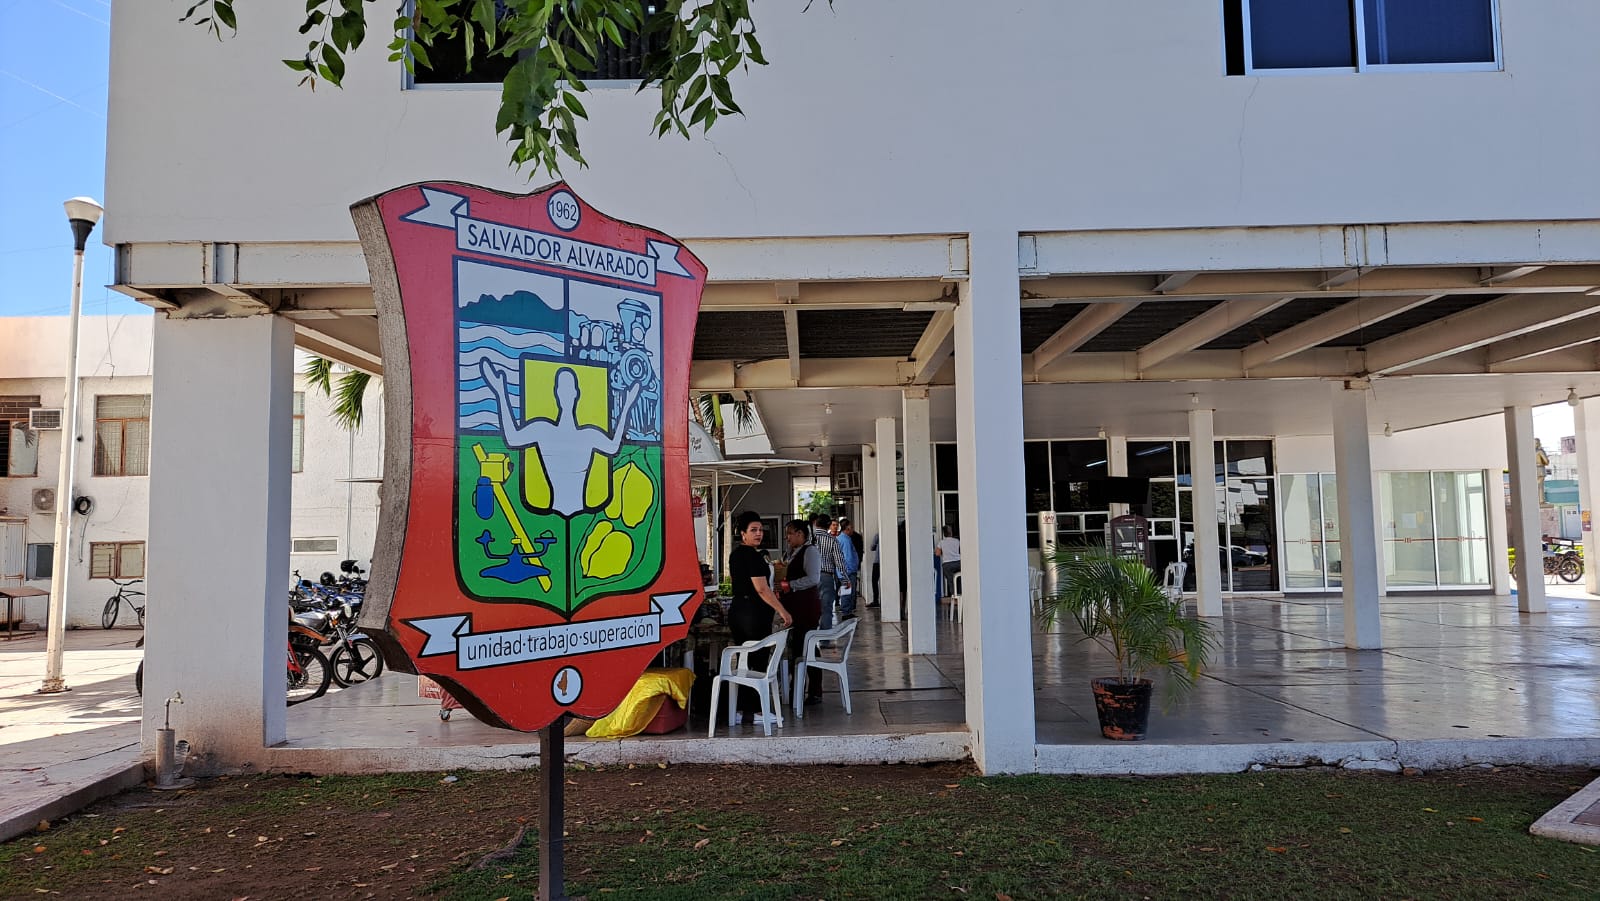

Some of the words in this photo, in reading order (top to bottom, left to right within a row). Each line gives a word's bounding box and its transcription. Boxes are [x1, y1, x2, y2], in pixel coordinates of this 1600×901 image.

[549, 199, 577, 222] 1962
[468, 224, 562, 262] SALVADOR
[566, 245, 649, 279] ALVARADO
